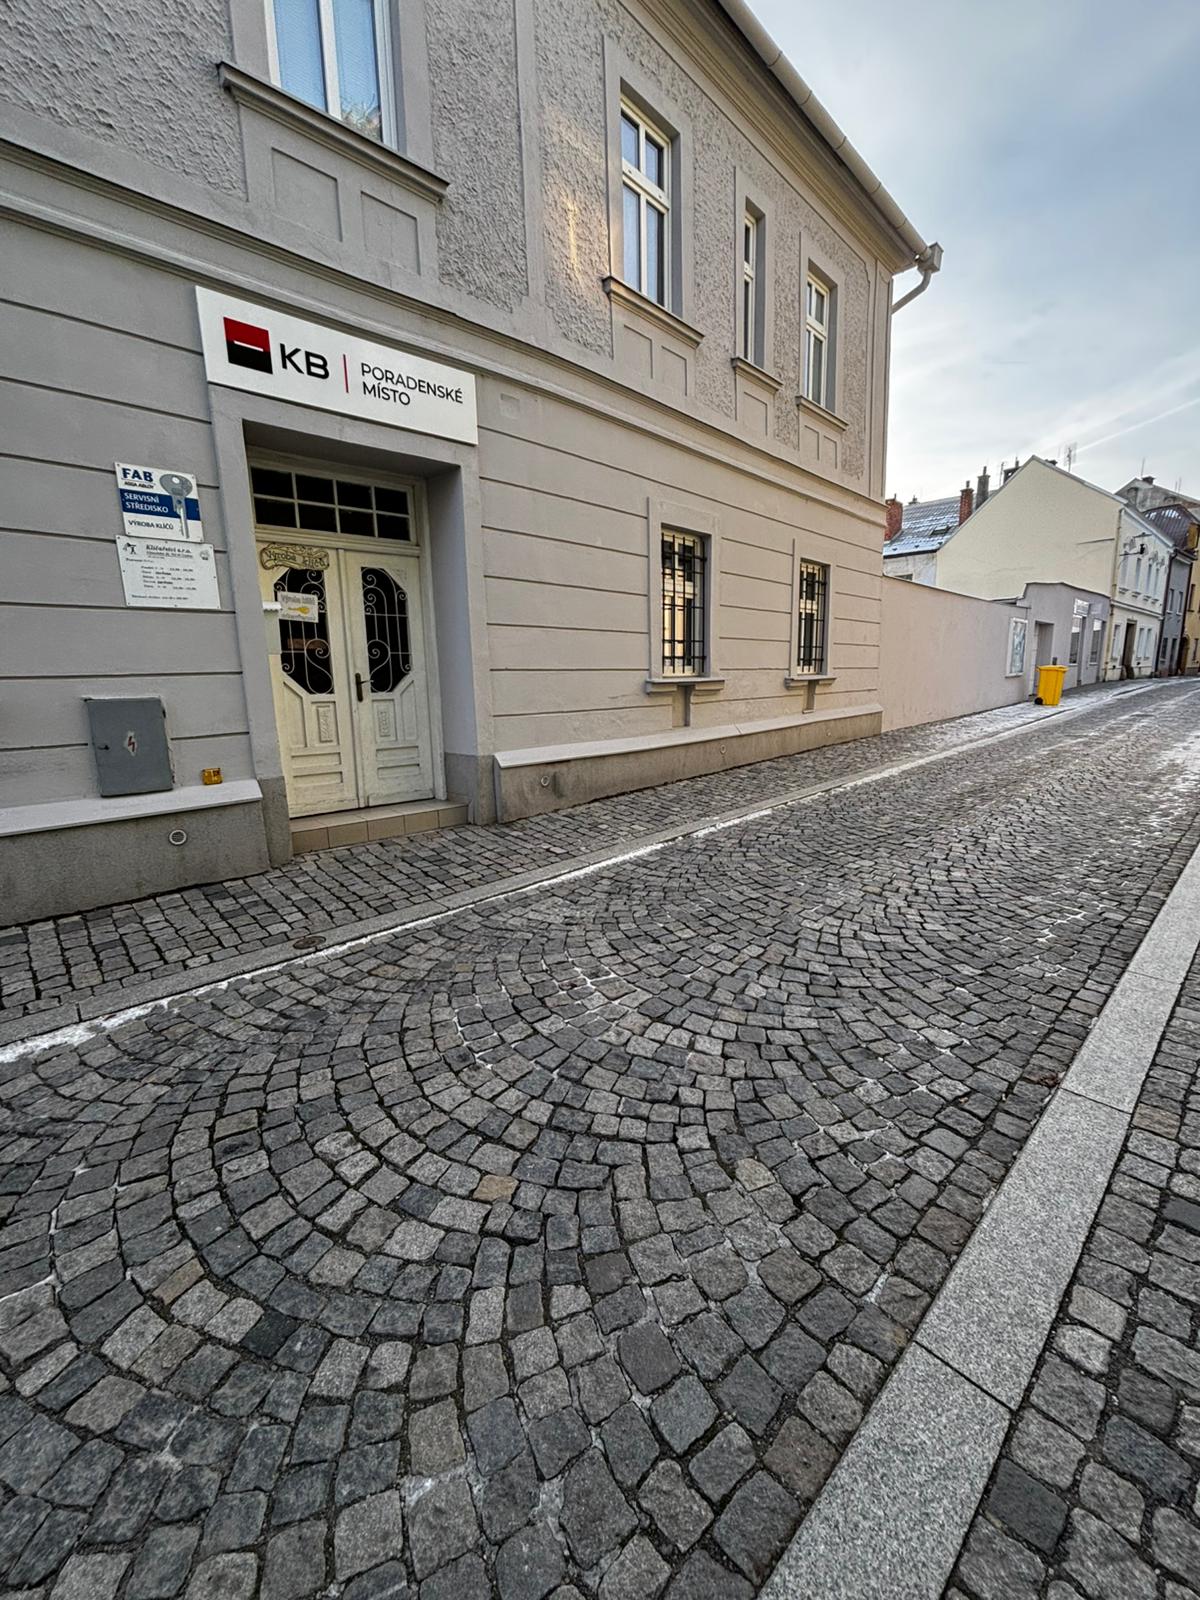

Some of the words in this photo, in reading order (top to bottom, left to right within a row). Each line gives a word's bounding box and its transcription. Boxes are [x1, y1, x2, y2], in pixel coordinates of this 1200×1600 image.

[280, 343, 330, 380] KB
[361, 362, 463, 404] PORADENSKÉ
[362, 381, 411, 406] MÍSTO
[121, 467, 154, 483] FAB
[124, 492, 160, 503] SERVISNÍ
[125, 501, 169, 513] STŘEDISKO
[128, 519, 155, 528] VÝROBA
[156, 521, 174, 530] KLÍČŮ
